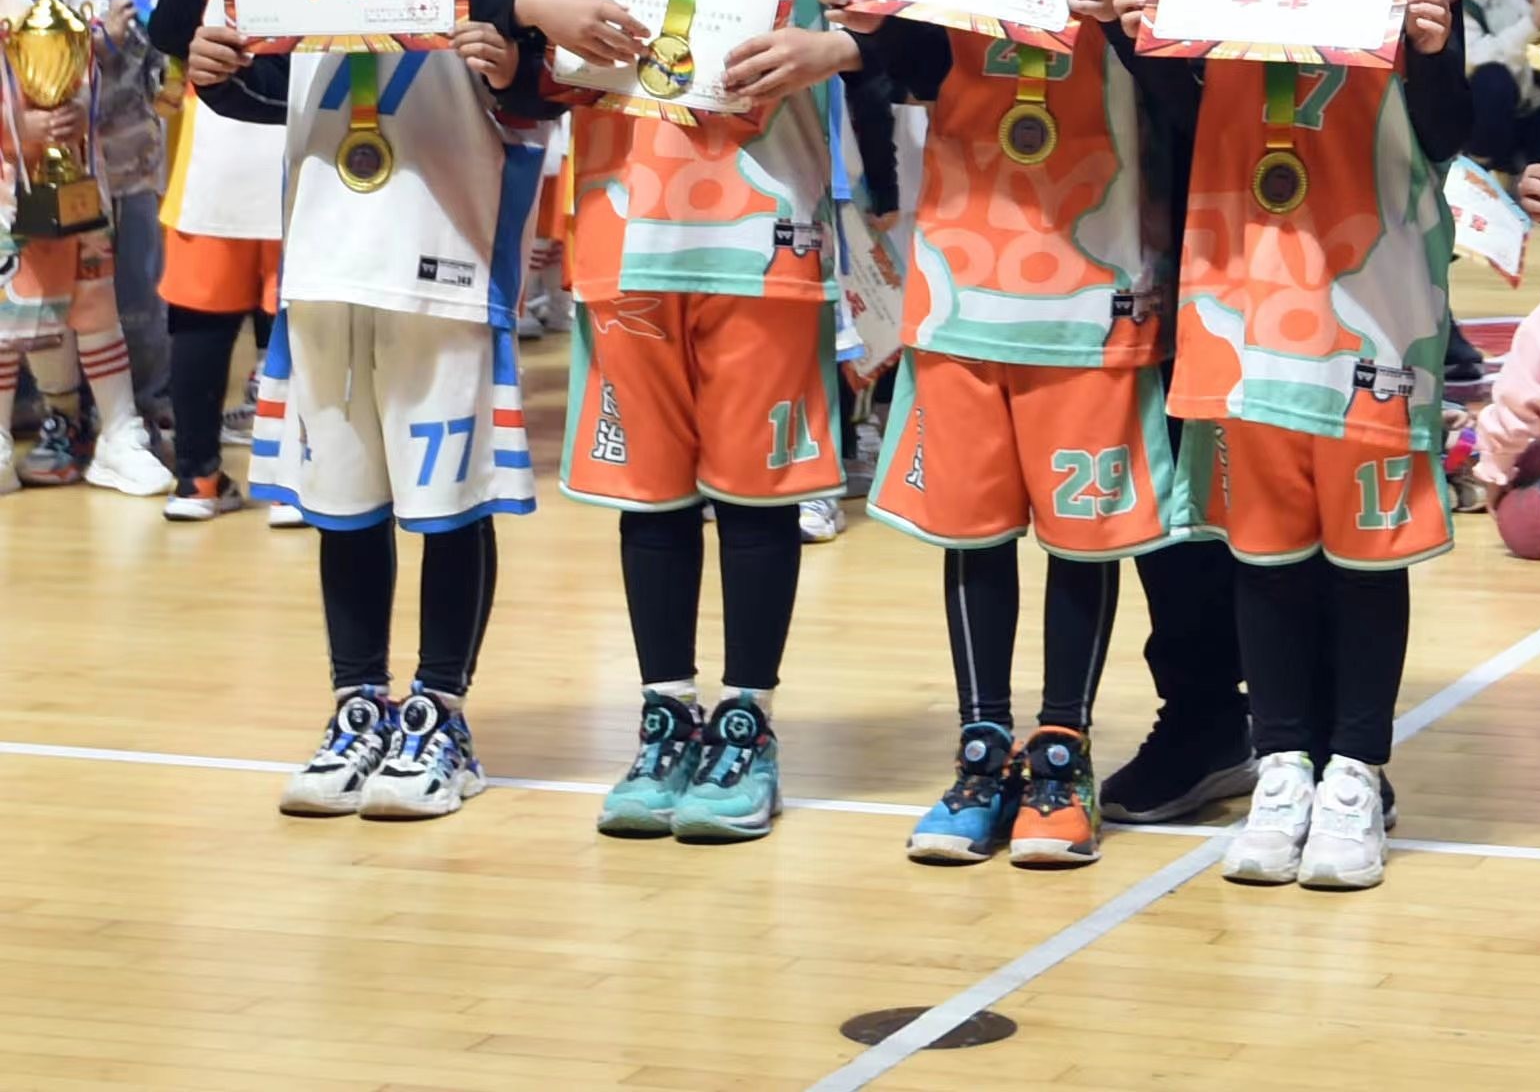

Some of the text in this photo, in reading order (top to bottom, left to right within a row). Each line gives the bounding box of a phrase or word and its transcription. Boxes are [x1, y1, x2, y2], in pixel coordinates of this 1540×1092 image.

[409, 415, 476, 488] 77
[767, 397, 820, 470] 11
[1051, 444, 1139, 520] 29
[1354, 454, 1416, 530] 17
